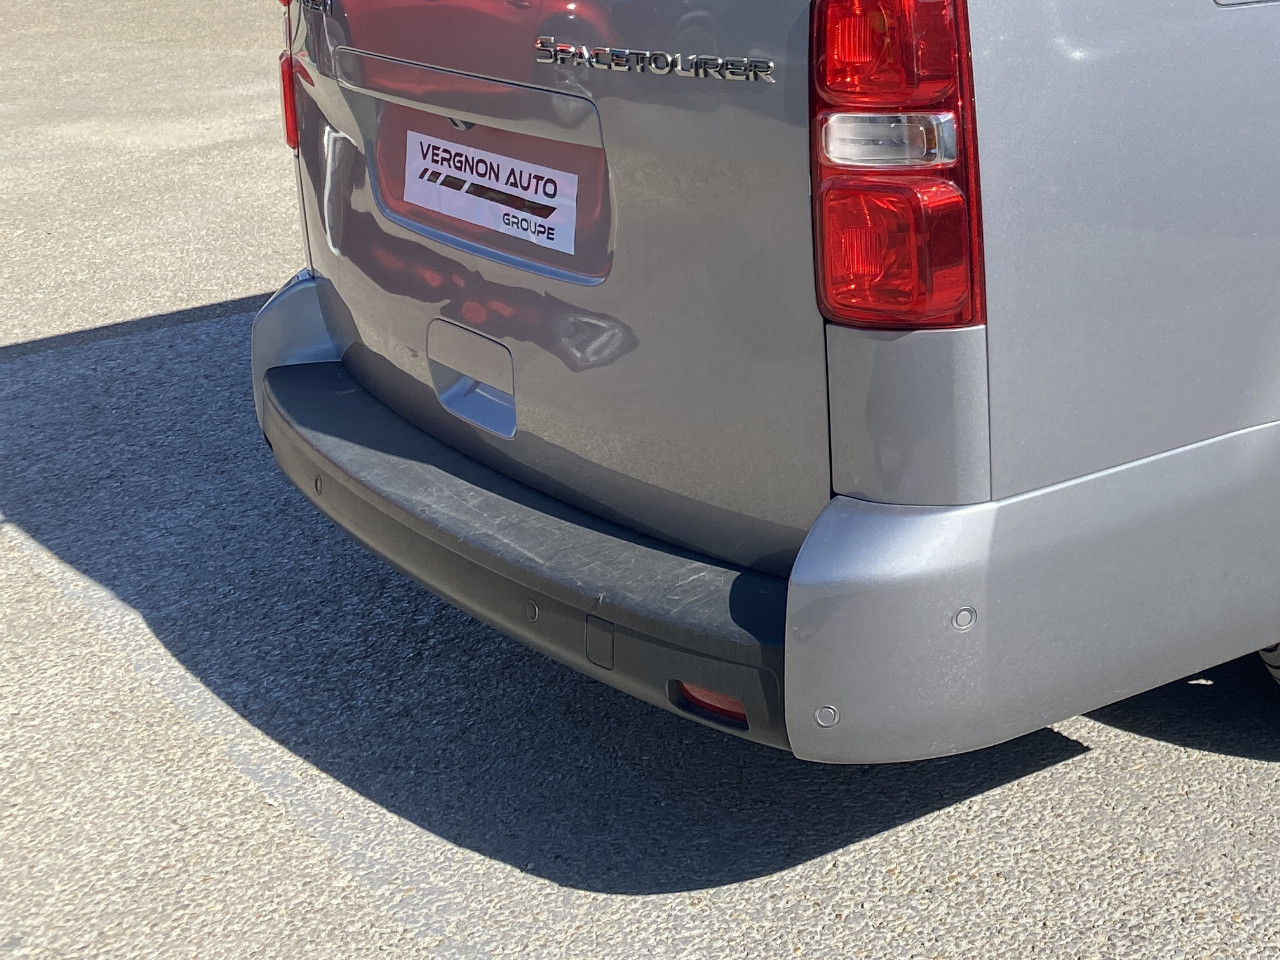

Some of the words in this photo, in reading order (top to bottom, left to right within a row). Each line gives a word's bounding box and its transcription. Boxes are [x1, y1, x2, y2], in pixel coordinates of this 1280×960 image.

[419, 141, 500, 182] VERGNON
[505, 167, 558, 199] AUTO
[502, 212, 555, 241] GROUPE
